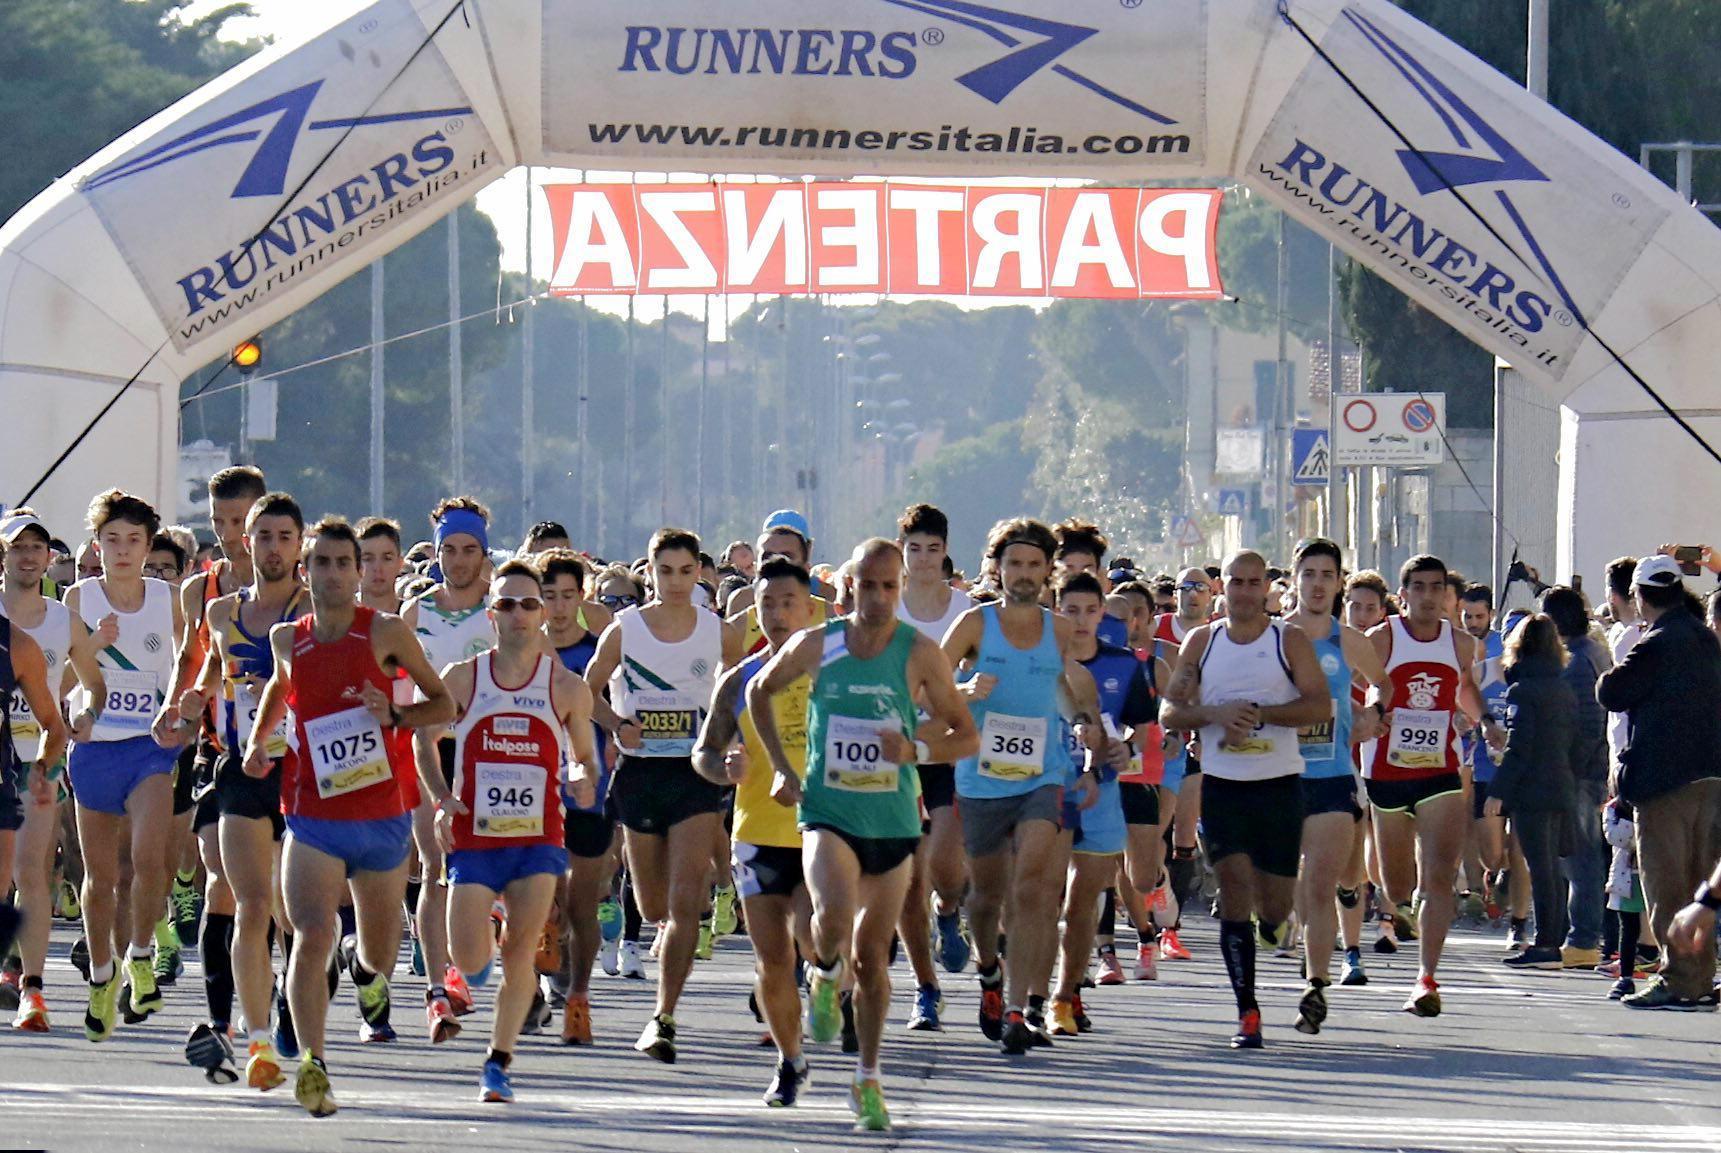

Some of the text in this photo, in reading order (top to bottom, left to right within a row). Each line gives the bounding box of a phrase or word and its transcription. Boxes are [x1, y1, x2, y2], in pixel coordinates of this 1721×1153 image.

[618, 26, 918, 80] RUNNERS
[587, 116, 1192, 156] www.runnersitalia.com
[175, 131, 456, 318] RUNNERS
[1277, 137, 1553, 336] RUNNERS
[180, 148, 489, 341] www.runnersitalia.it
[1258, 163, 1559, 368] www.runnersitalia.it
[640, 711, 692, 731] 2033/1
[1400, 728, 1439, 746] 998
[317, 730, 377, 765] 1075
[833, 741, 880, 763] 100
[991, 735, 1034, 756] 368
[487, 786, 534, 807] 946
